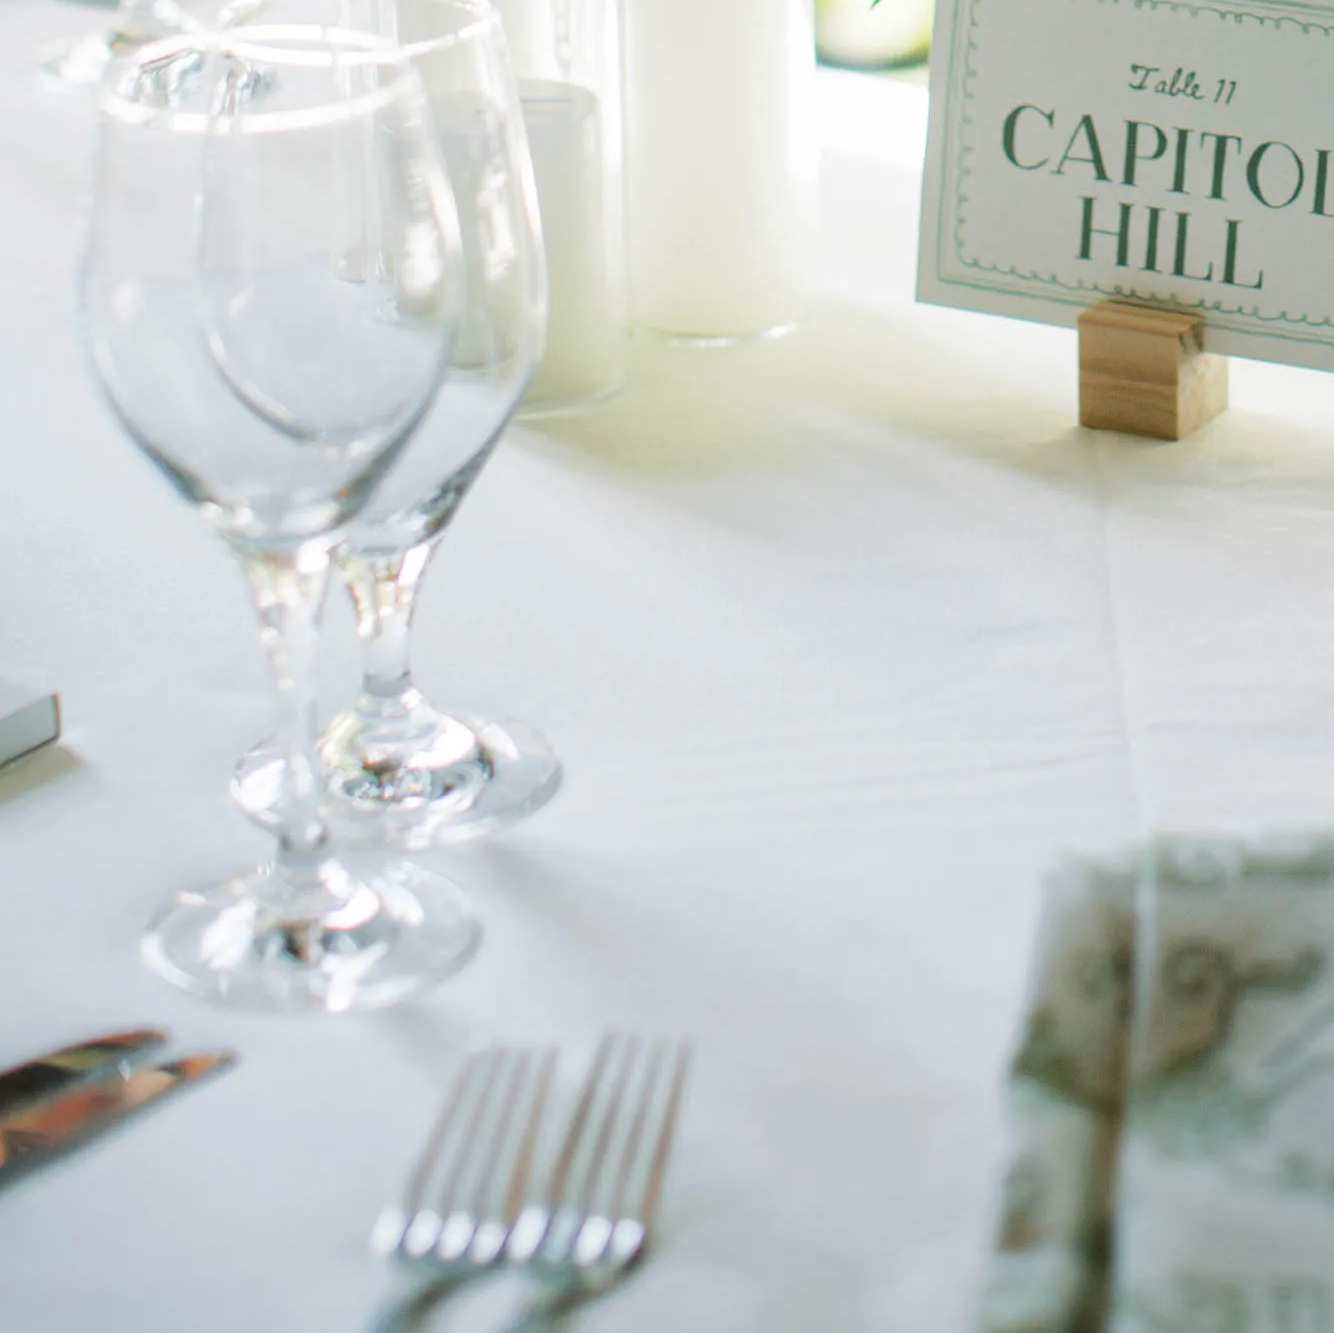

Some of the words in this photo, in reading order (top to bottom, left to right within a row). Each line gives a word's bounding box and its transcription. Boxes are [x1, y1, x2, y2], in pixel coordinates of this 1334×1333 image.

[1128, 63, 1205, 100] Table
[1213, 78, 1237, 105] 11
[1075, 195, 1263, 290] HILL
